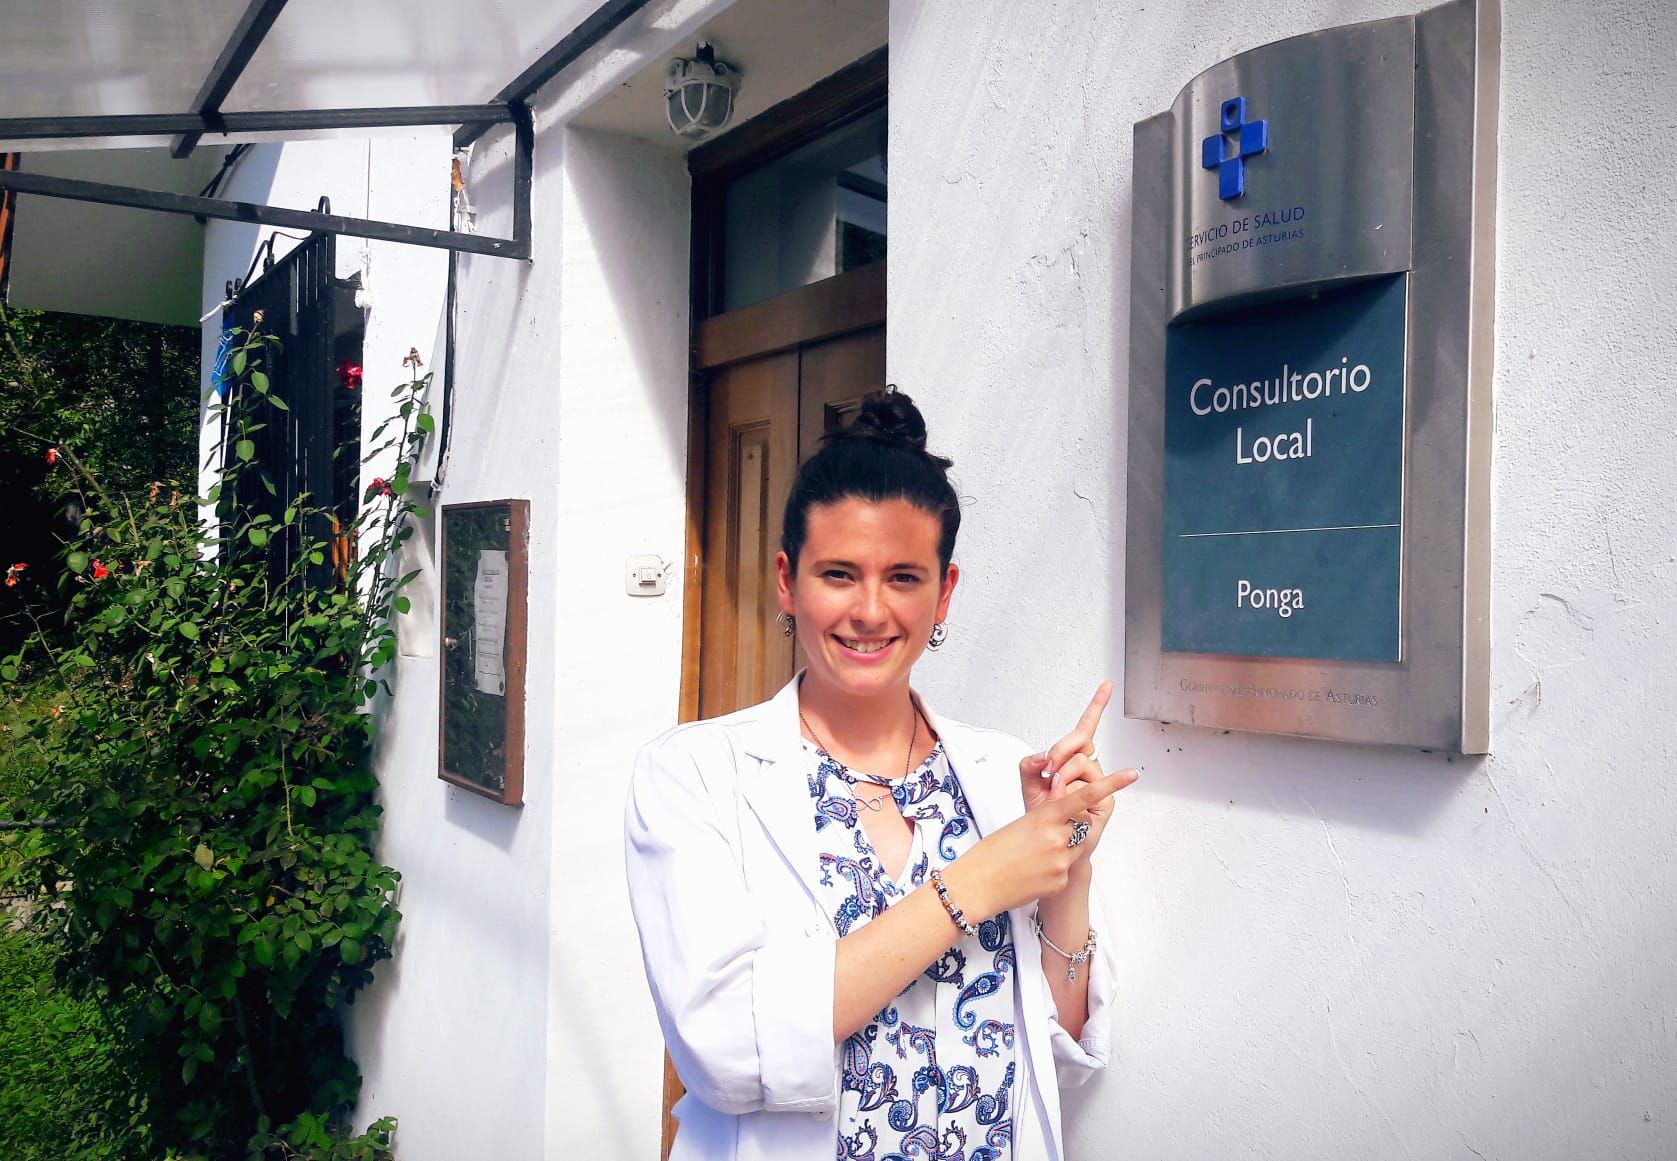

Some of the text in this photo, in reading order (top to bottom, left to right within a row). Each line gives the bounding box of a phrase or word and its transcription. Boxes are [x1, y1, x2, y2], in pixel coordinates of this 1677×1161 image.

[1232, 217, 1249, 235] DE
[1254, 206, 1305, 229] SALUD
[1196, 242, 1240, 263] PRINCIPADO
[1242, 237, 1253, 250] DE
[1255, 228, 1305, 246] ASTURIAS
[1190, 356, 1371, 416] Consultorio
[1236, 418, 1312, 465] Local
[1236, 580, 1304, 617] Ponga
